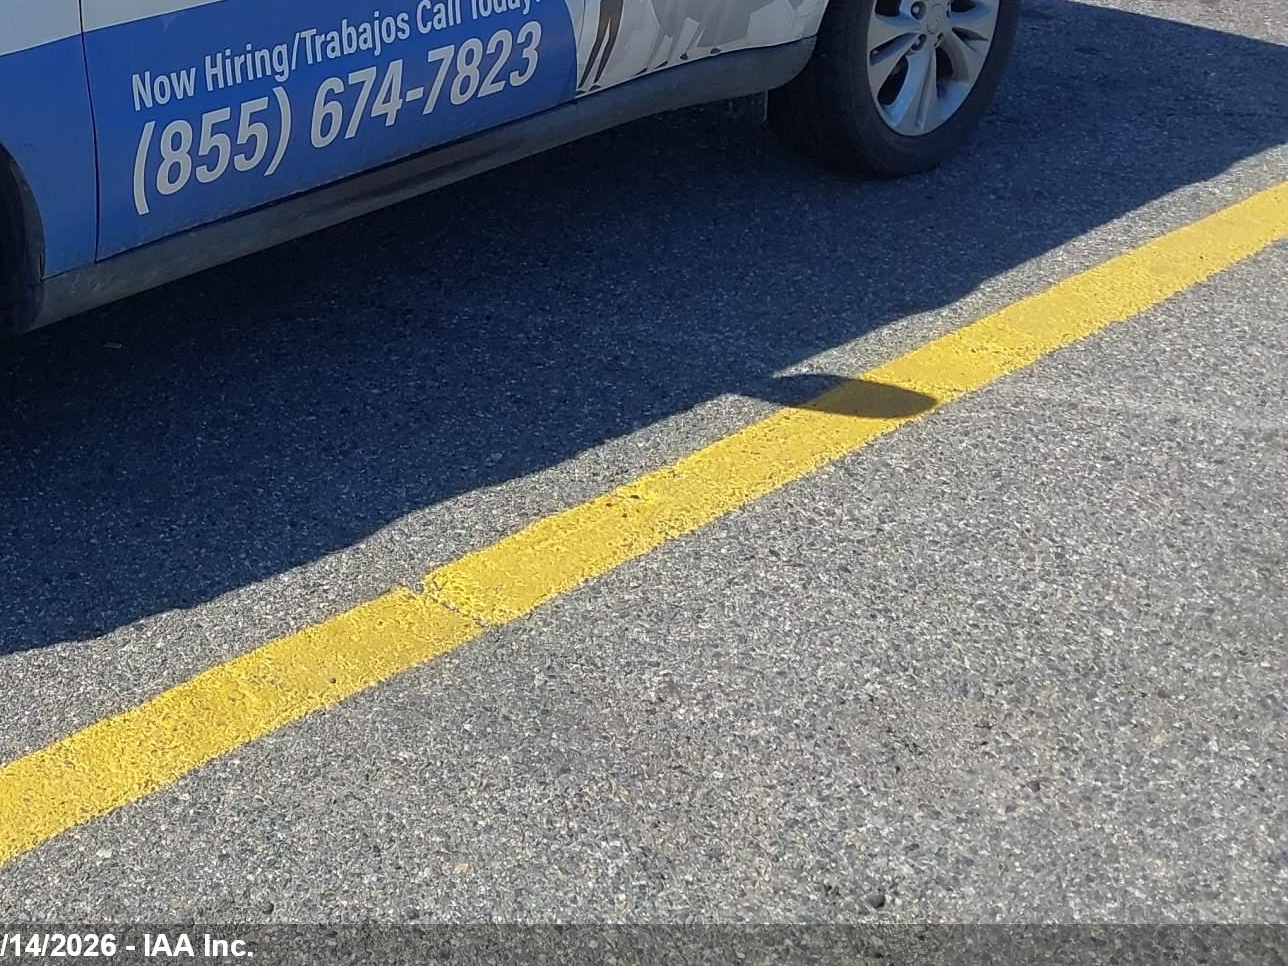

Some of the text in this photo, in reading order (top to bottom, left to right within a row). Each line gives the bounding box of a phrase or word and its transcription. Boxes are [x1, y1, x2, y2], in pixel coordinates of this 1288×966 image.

[131, 67, 196, 112] Now
[204, 10, 411, 92] Hiring/Trabajos
[132, 20, 543, 216] (855) 674-7823
